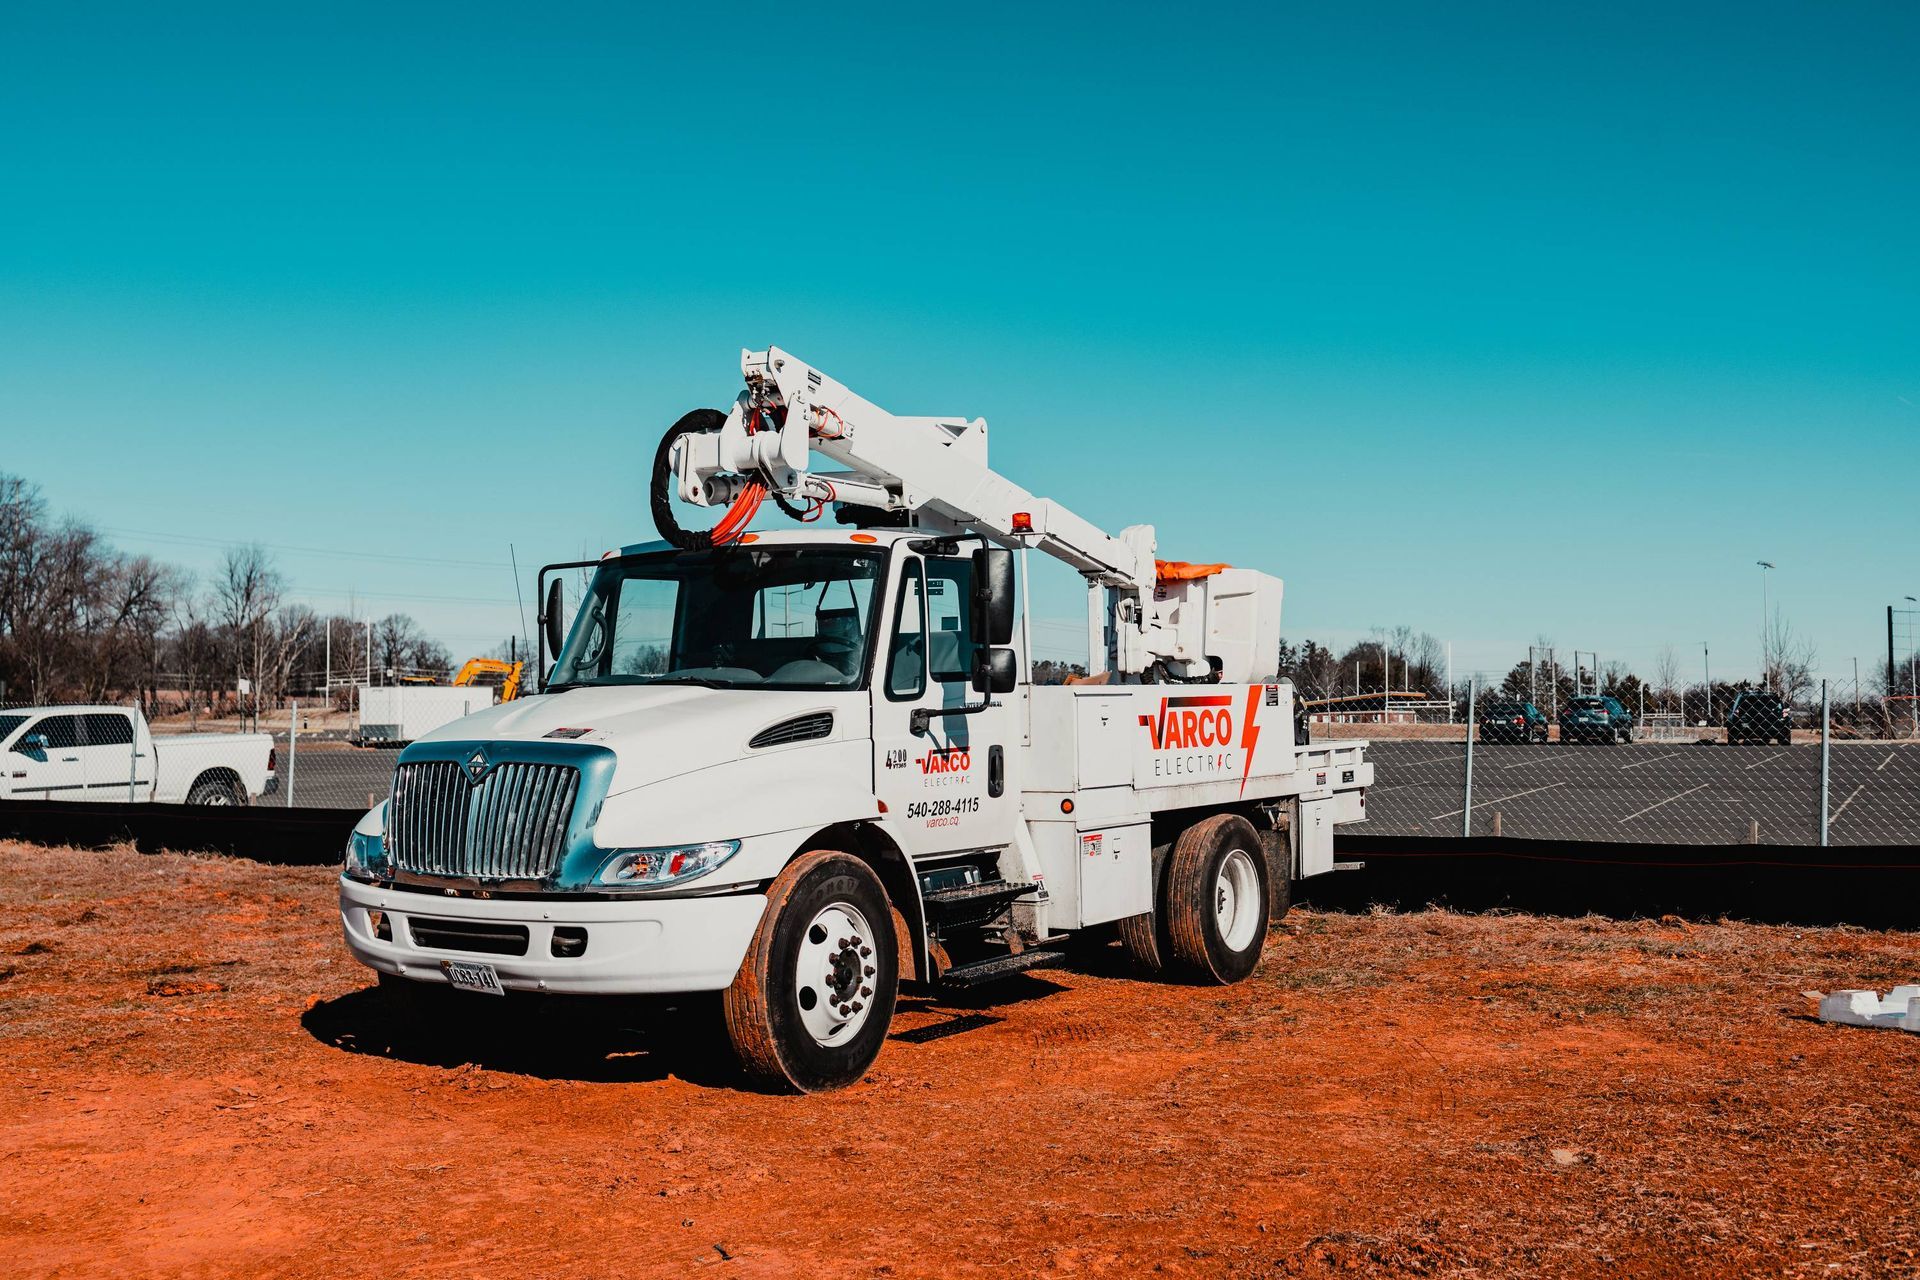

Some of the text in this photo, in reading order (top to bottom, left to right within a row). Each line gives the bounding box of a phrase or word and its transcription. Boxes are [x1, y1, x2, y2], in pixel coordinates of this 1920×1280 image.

[1138, 695, 1232, 749] VARCO
[886, 749, 907, 769] 4200
[916, 746, 970, 774] VARCO
[1155, 753, 1232, 776] ELECTRIC
[924, 775, 970, 788] ELECTRIC
[907, 797, 979, 818] 540-288-4115
